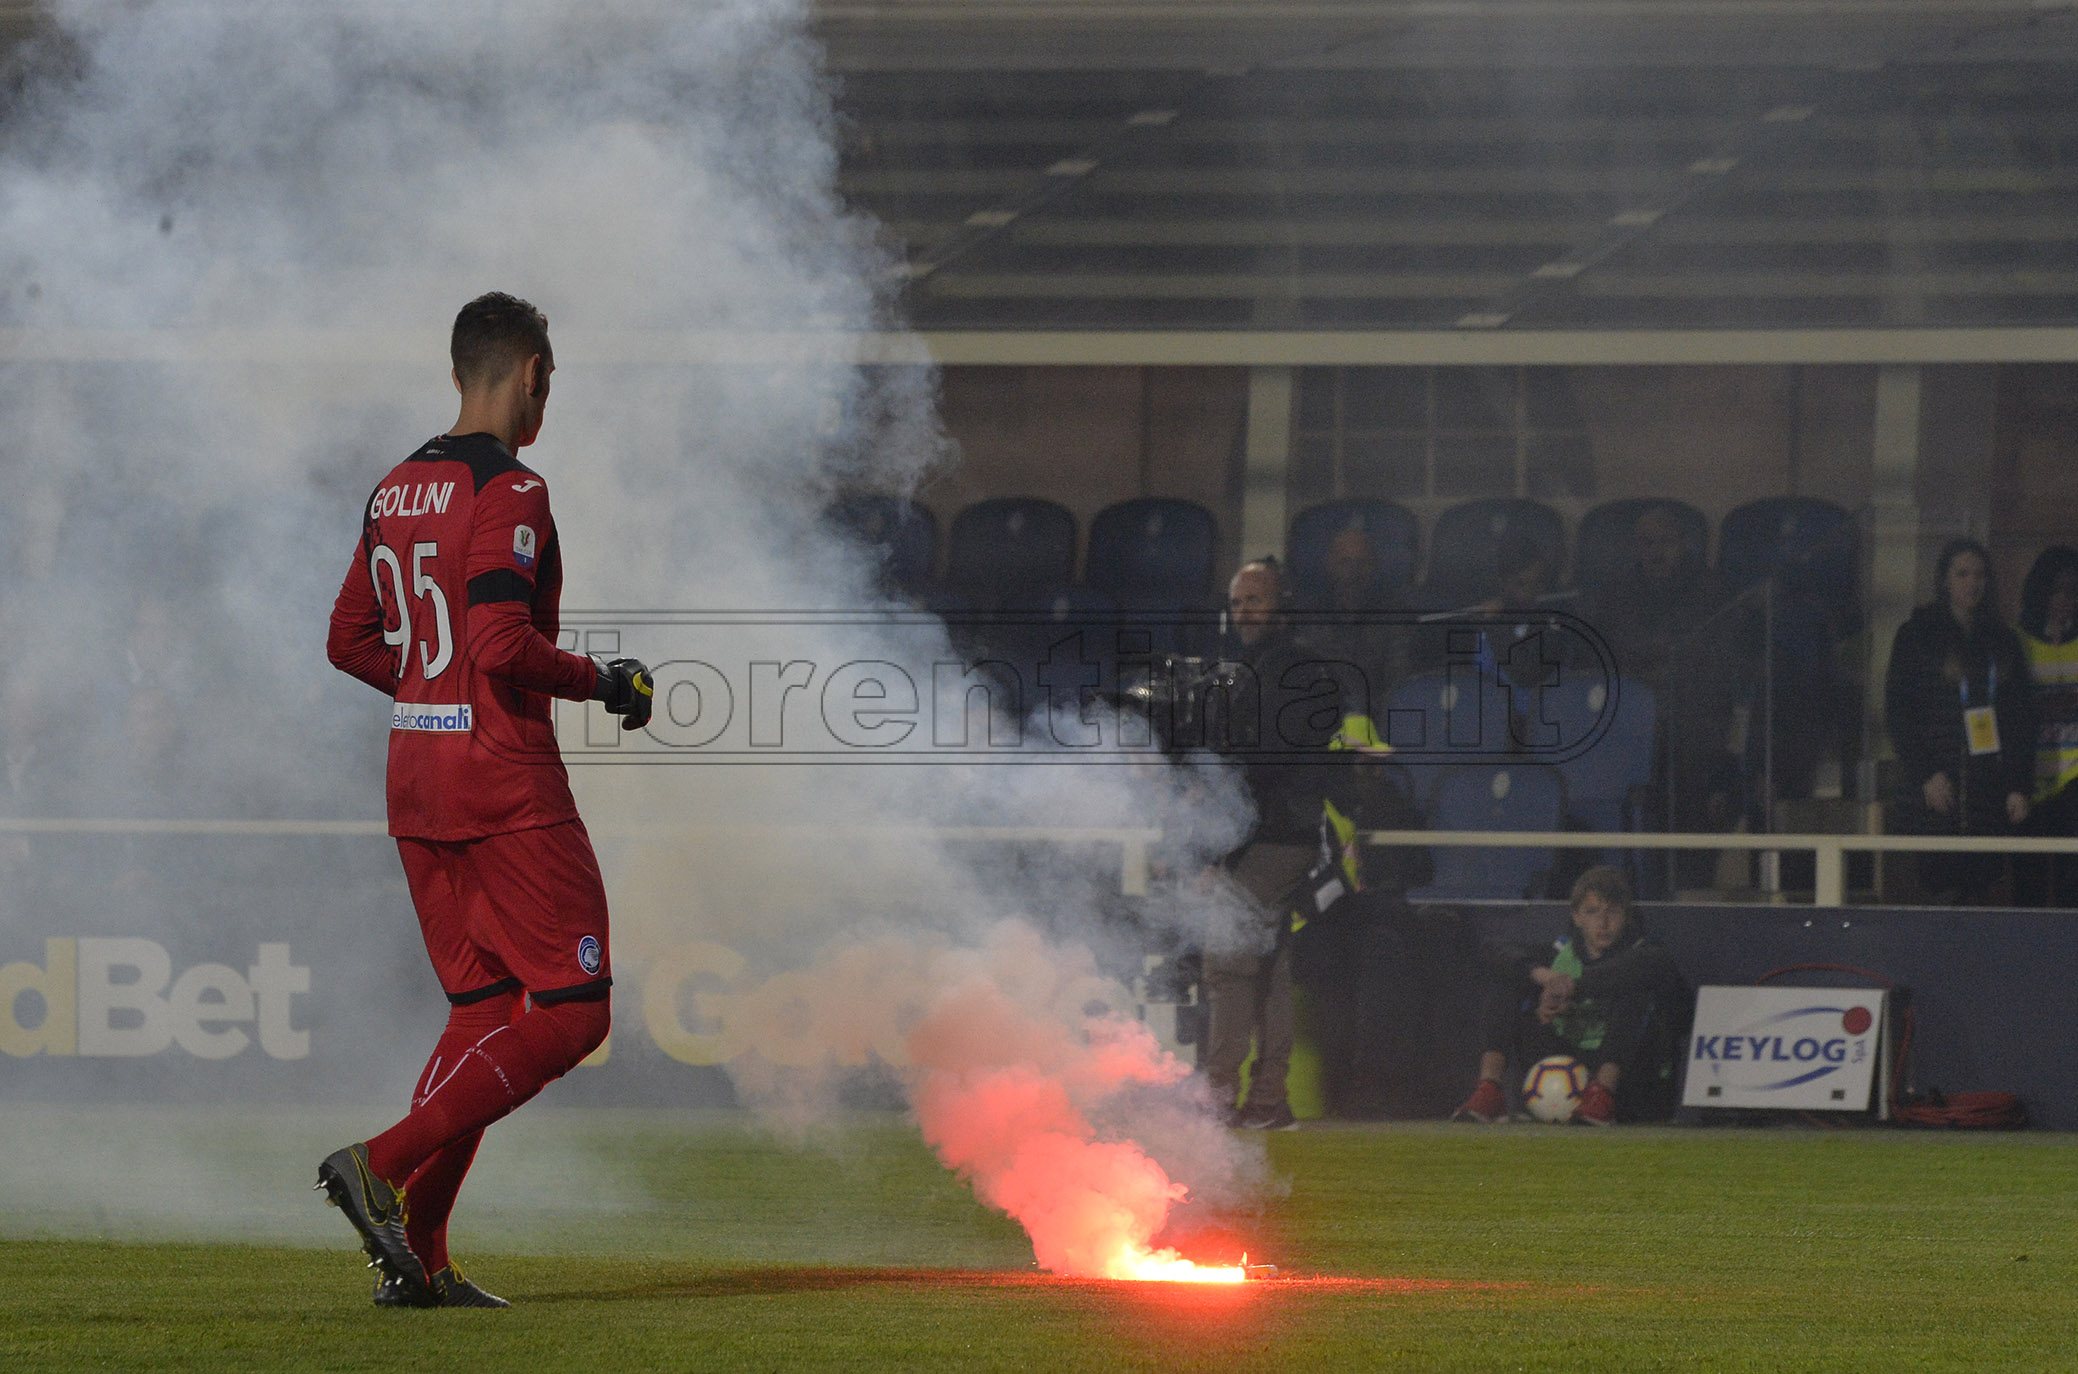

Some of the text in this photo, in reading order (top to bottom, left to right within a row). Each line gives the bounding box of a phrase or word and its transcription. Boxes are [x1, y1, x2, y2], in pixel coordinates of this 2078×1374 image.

[370, 482, 455, 520] GOLLINI
[370, 541, 454, 680] 95
[1694, 1035, 1846, 1062] KEYLOG
